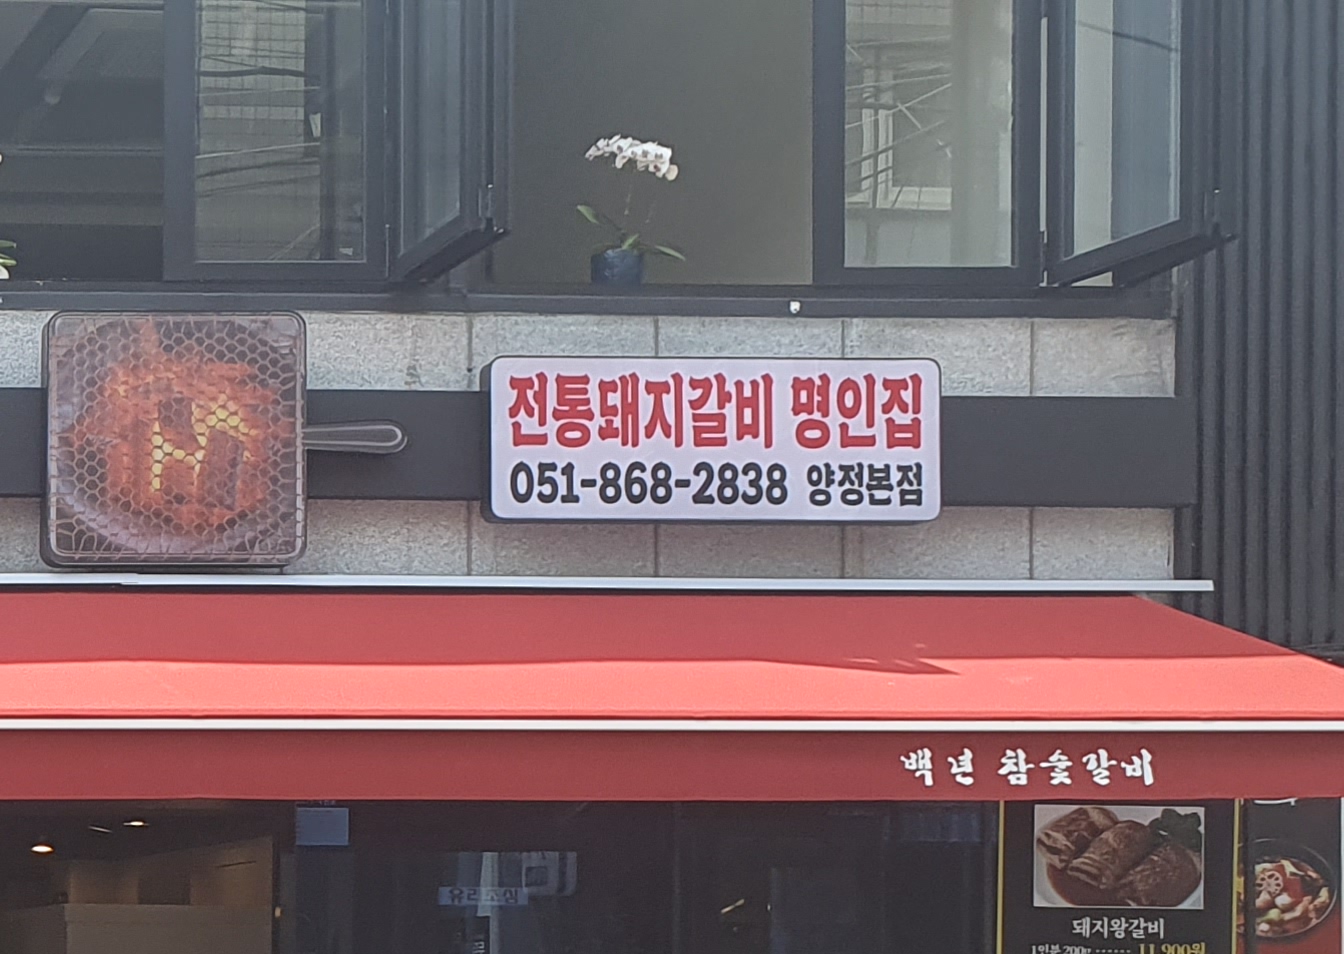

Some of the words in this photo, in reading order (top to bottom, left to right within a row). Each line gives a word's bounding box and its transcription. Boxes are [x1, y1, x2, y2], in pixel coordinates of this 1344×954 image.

[508, 372, 774, 449] 전통돼지갈비
[791, 373, 923, 450] 명인집
[510, 461, 789, 505] 051-868-2838
[806, 461, 924, 507] 양정본점
[900, 747, 975, 787] 백년
[997, 748, 1155, 787] 참숯갈비
[1072, 917, 1165, 939] 돼지왕갈비
